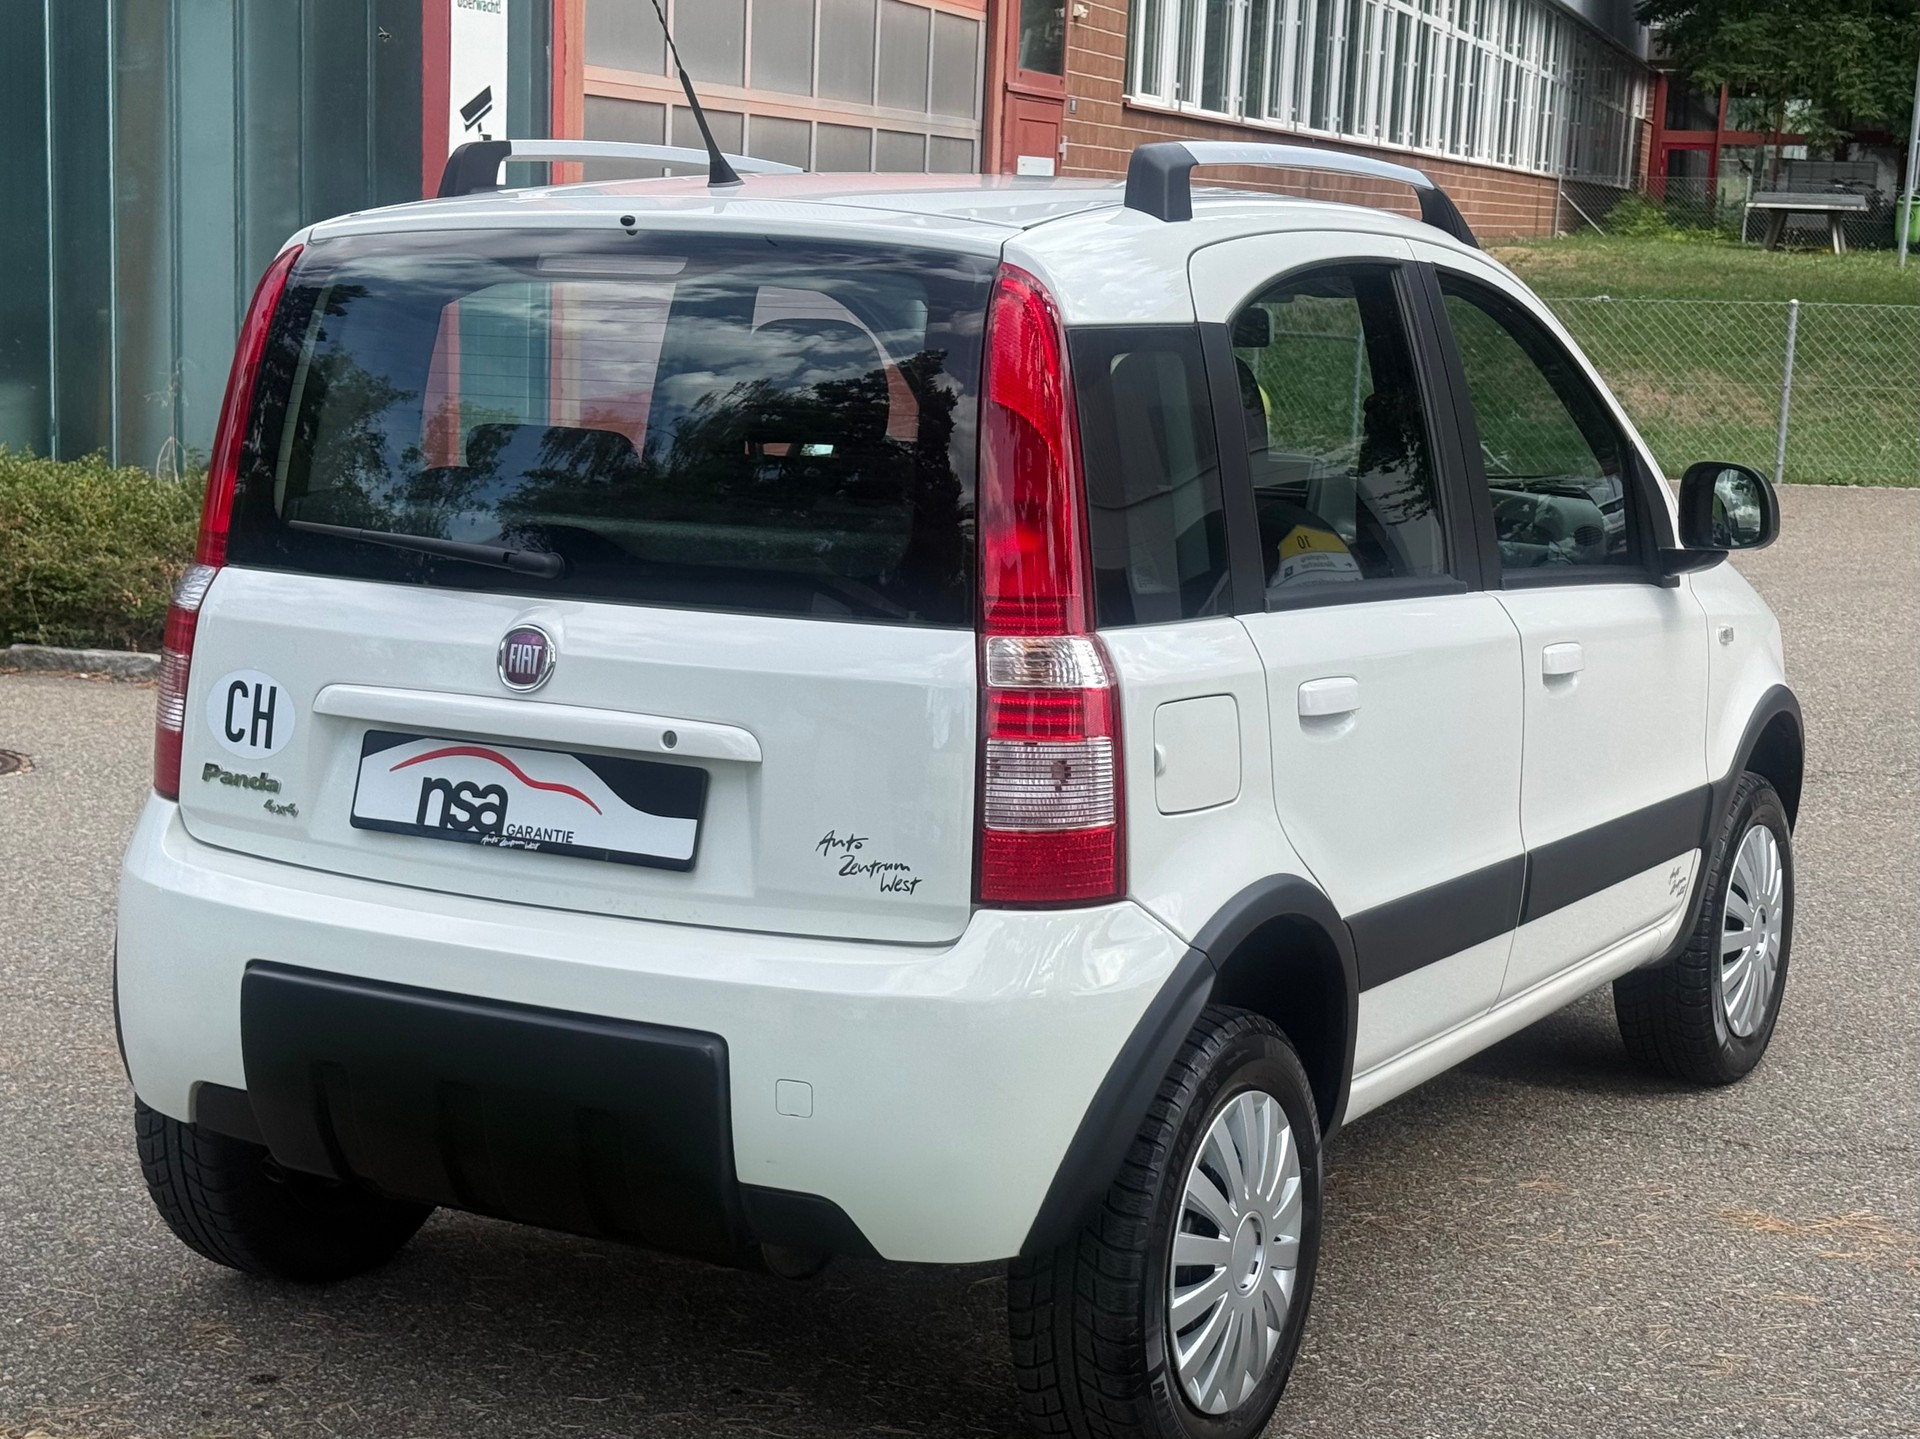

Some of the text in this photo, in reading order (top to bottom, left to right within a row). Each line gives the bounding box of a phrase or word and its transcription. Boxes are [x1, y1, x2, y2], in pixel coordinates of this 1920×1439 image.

[508, 643, 542, 675] FIAT
[225, 680, 277, 749] CH
[202, 762, 281, 794] Panda
[263, 799, 299, 818] 4x4
[416, 777, 508, 836] nsa
[506, 823, 575, 844] GARANTIE
[815, 829, 869, 857] Auto
[838, 854, 911, 878] Zentrum
[880, 872, 923, 895] West
